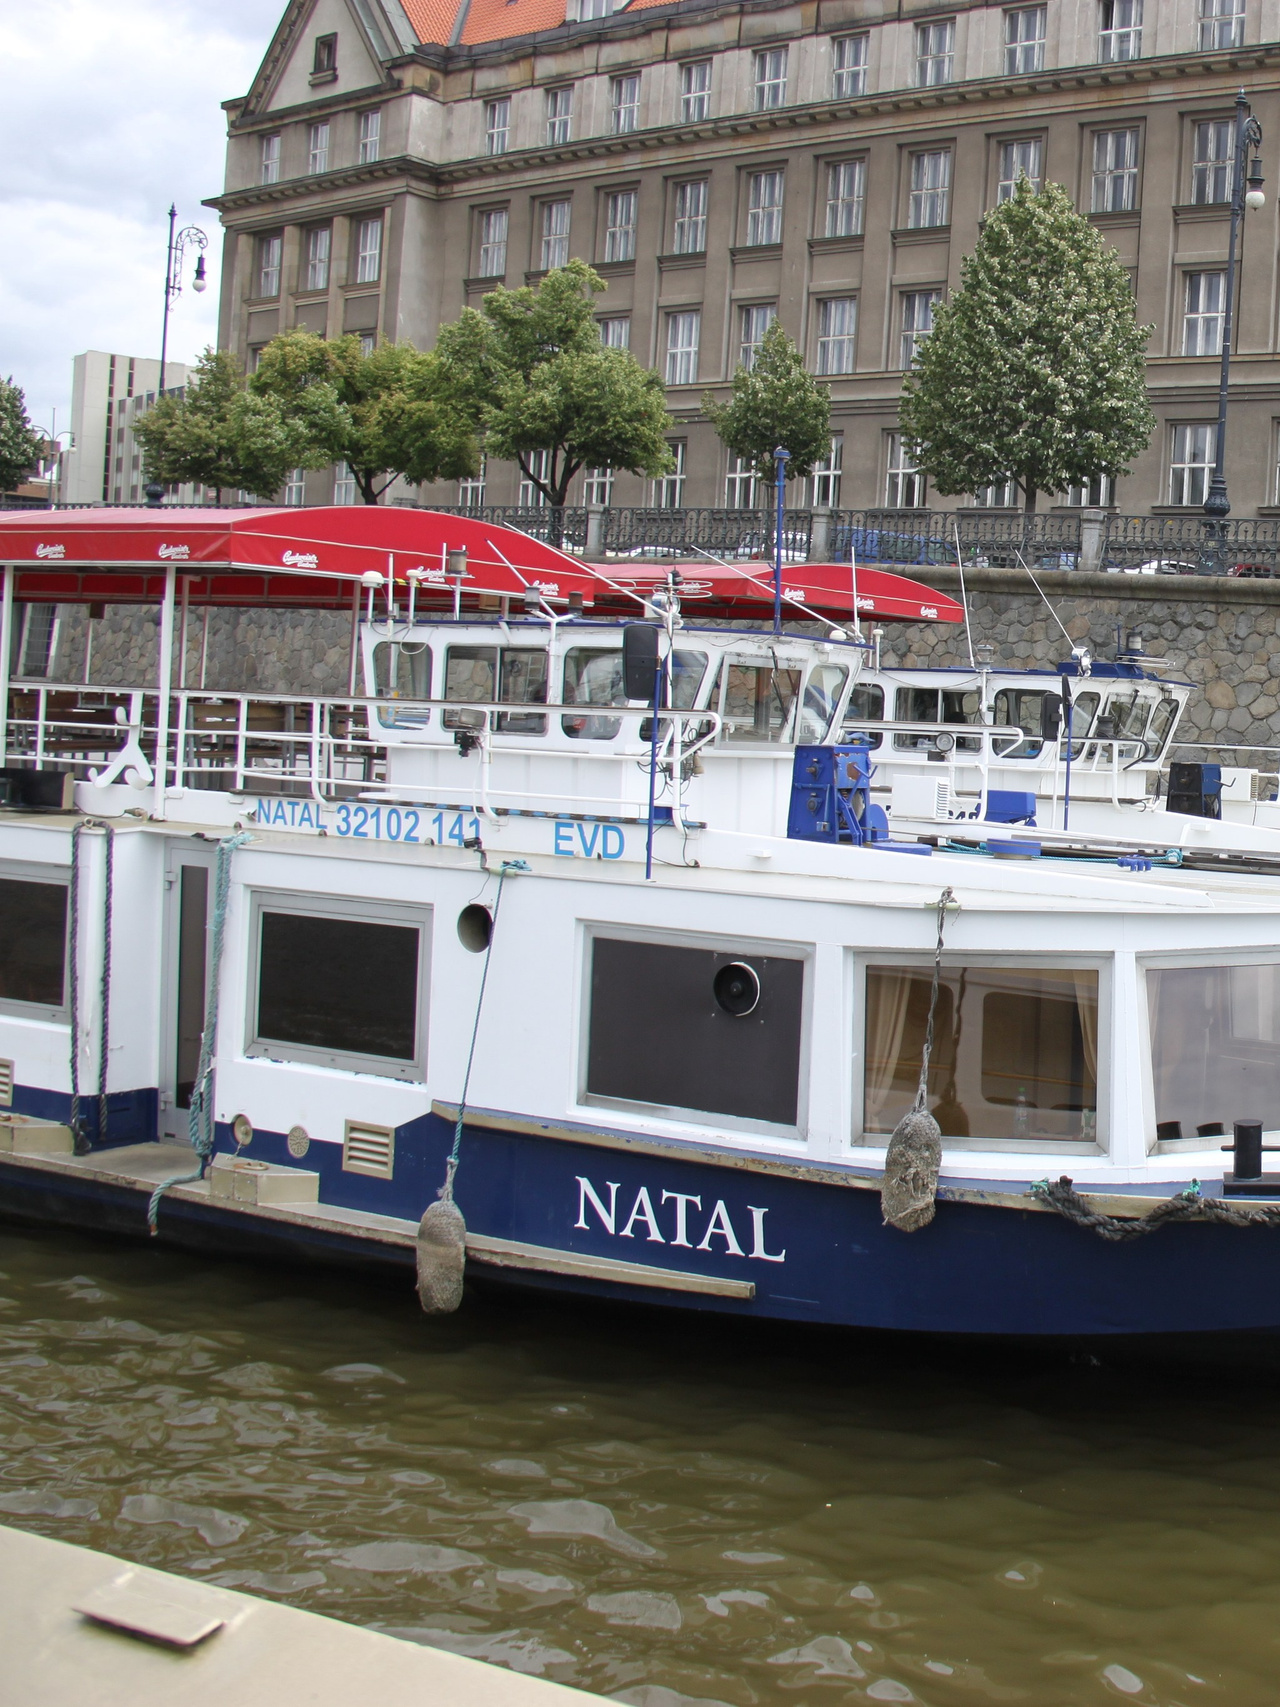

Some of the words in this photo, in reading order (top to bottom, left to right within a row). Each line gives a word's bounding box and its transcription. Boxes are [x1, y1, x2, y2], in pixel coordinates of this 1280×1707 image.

[257, 799, 328, 829] NATAL
[336, 804, 420, 843] 32102
[432, 811, 481, 847] 141
[554, 822, 625, 860] EVD
[574, 1175, 786, 1263] NATAL
